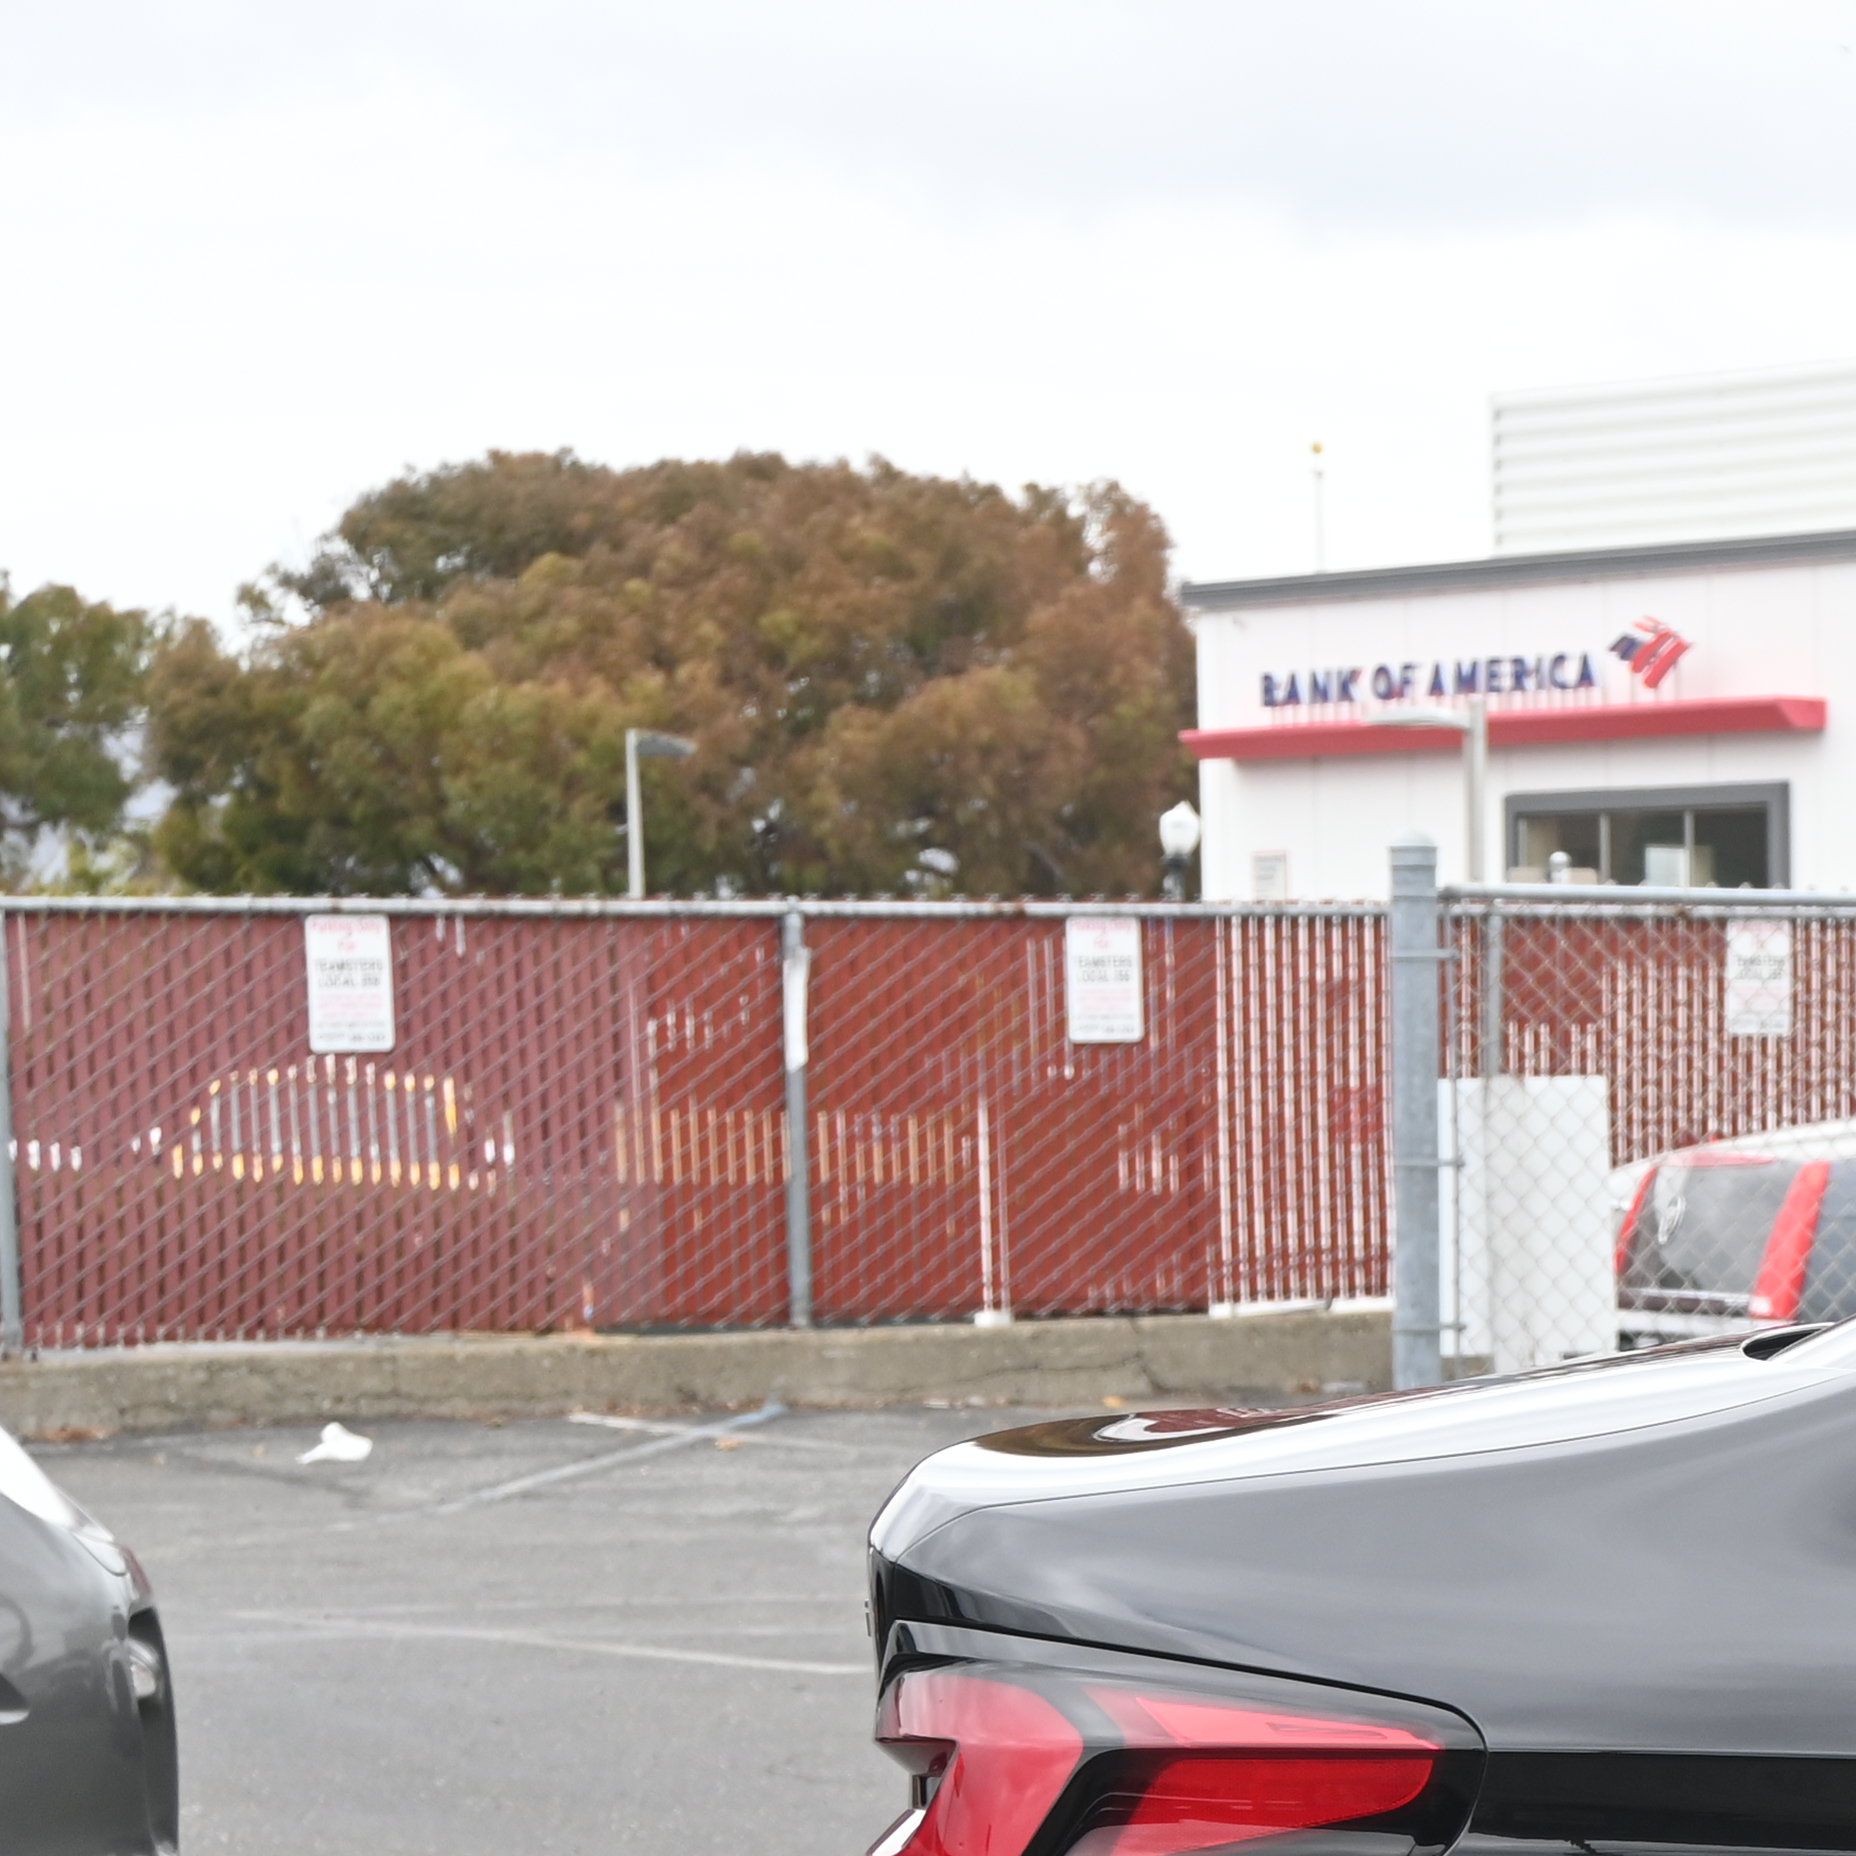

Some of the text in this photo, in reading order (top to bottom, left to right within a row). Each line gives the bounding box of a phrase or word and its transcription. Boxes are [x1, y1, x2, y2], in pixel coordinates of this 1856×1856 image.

[1260, 652, 1596, 707] BANK OF AMERICA
